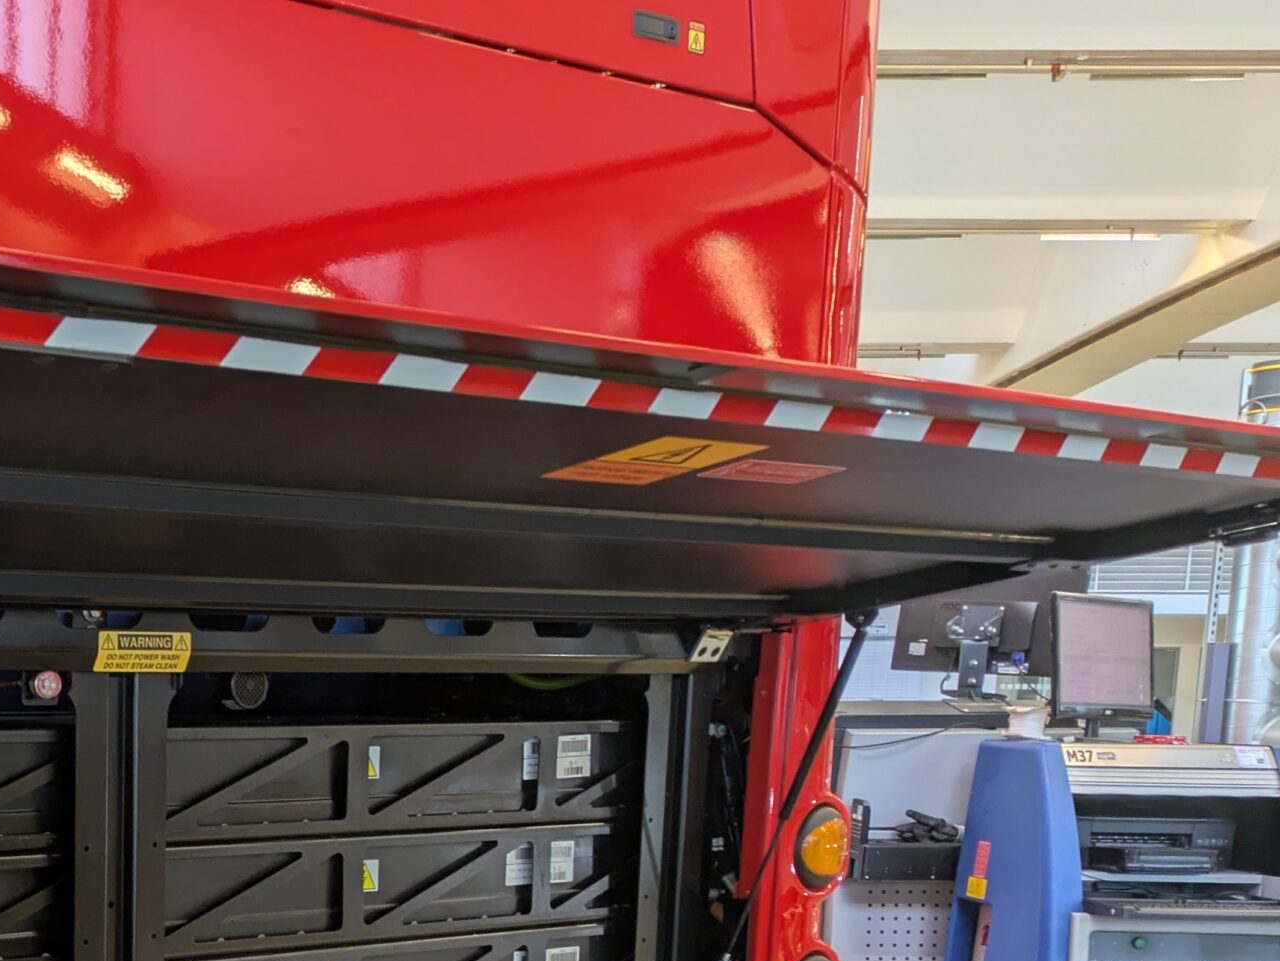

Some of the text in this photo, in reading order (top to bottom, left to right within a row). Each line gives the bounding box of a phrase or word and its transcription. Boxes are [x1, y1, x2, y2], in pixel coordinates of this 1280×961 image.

[119, 636, 172, 649] WARNING
[106, 653, 181, 662] DO NOT POWER WASH
[103, 662, 179, 670] DO NOT STEAM CLEAN
[1066, 750, 1094, 763] M37
